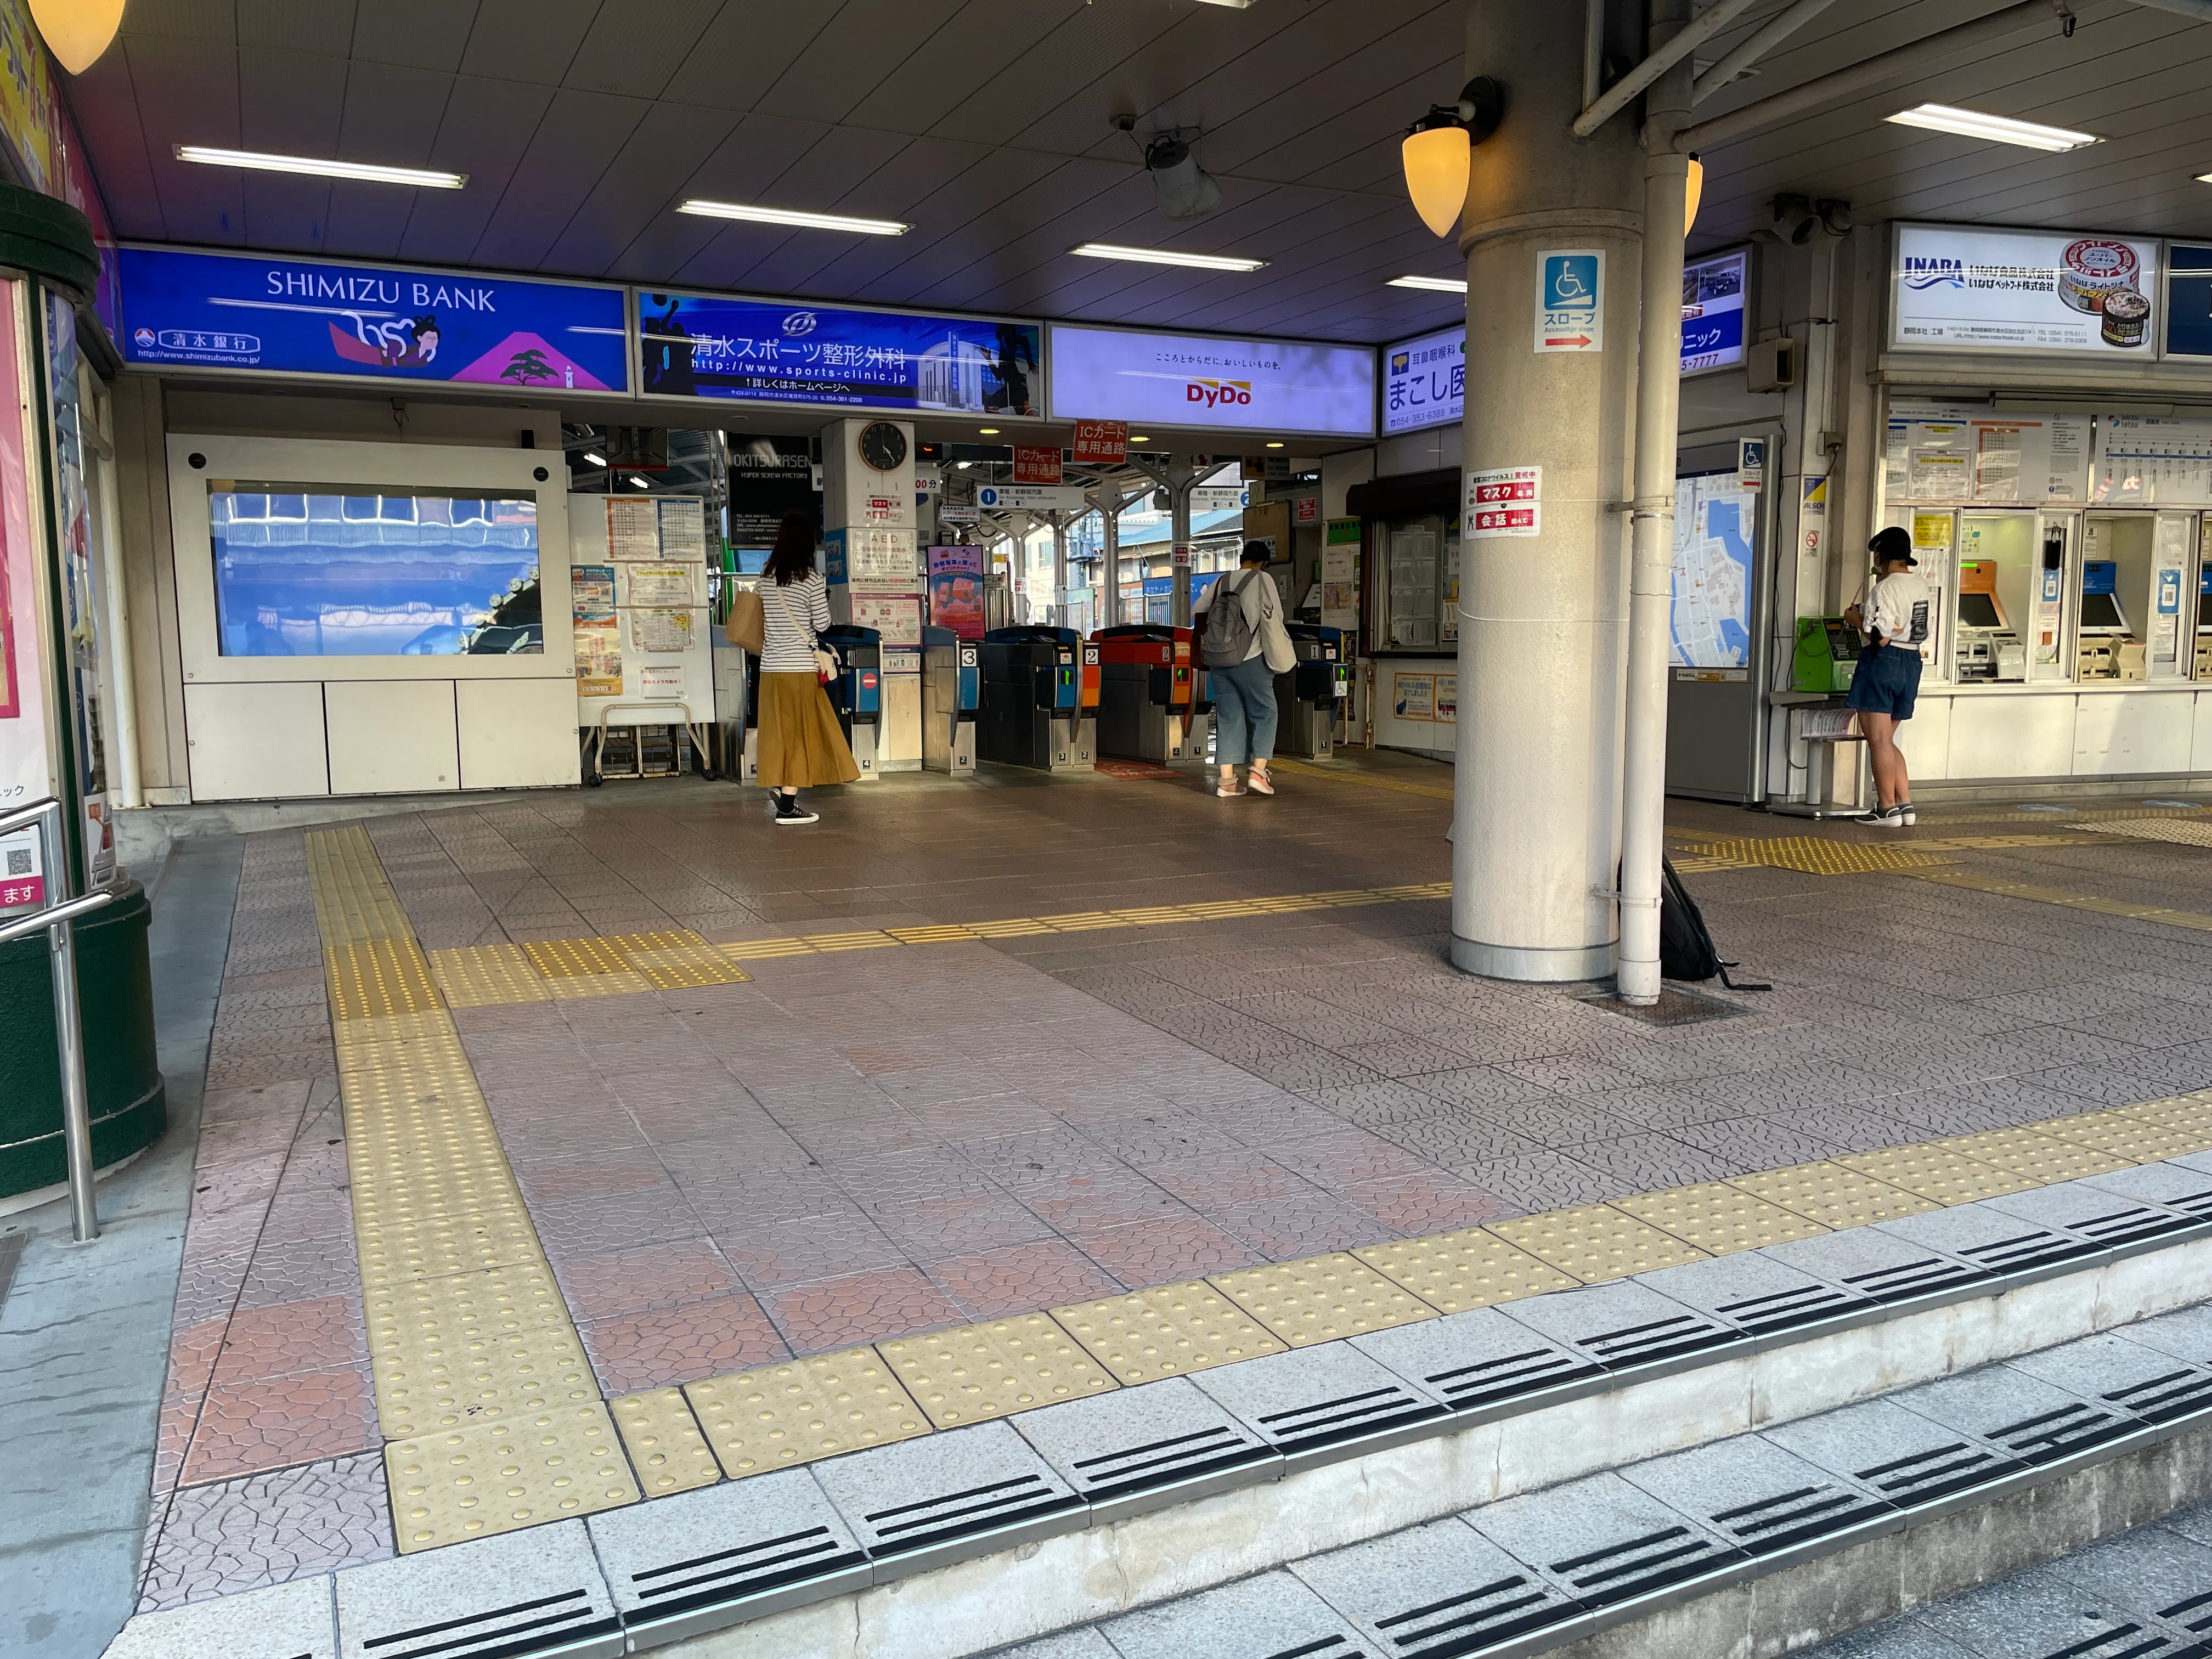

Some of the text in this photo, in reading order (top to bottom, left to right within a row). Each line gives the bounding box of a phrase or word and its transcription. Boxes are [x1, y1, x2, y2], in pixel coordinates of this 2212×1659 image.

[1904, 257, 1965, 283] INABA
[267, 271, 495, 312] SHIMIZU BANK
[1969, 278, 2055, 291] いなばペットフード株式会社
[1544, 312, 1596, 325] スロープ
[173, 333, 247, 349] 清水銀行
[138, 349, 260, 365] http://www.shimizubank.co.jp/
[690, 332, 906, 370] 清水スポーツ整形外科
[1412, 343, 1455, 365] 耳鼻咽喉科
[1156, 353, 1281, 370] こころとからだに、おいしいものを。
[1681, 353, 1719, 371] 5-7777
[691, 358, 907, 383] http://www.sports-clinic.jp
[752, 378, 850, 392] 詳しくはホームページへ
[1187, 383, 1251, 408] DyDo
[1079, 426, 1126, 440] ICカード
[1018, 448, 1060, 462] ICカード
[1076, 441, 1126, 456] 専用通路
[1015, 462, 1061, 476] 専用通路
[1482, 486, 1511, 499] マスク
[871, 534, 898, 543] AED
[963, 650, 975, 665] 3
[1087, 651, 1096, 663] 2
[1163, 647, 1169, 660] 2
[3, 884, 35, 904] ます
